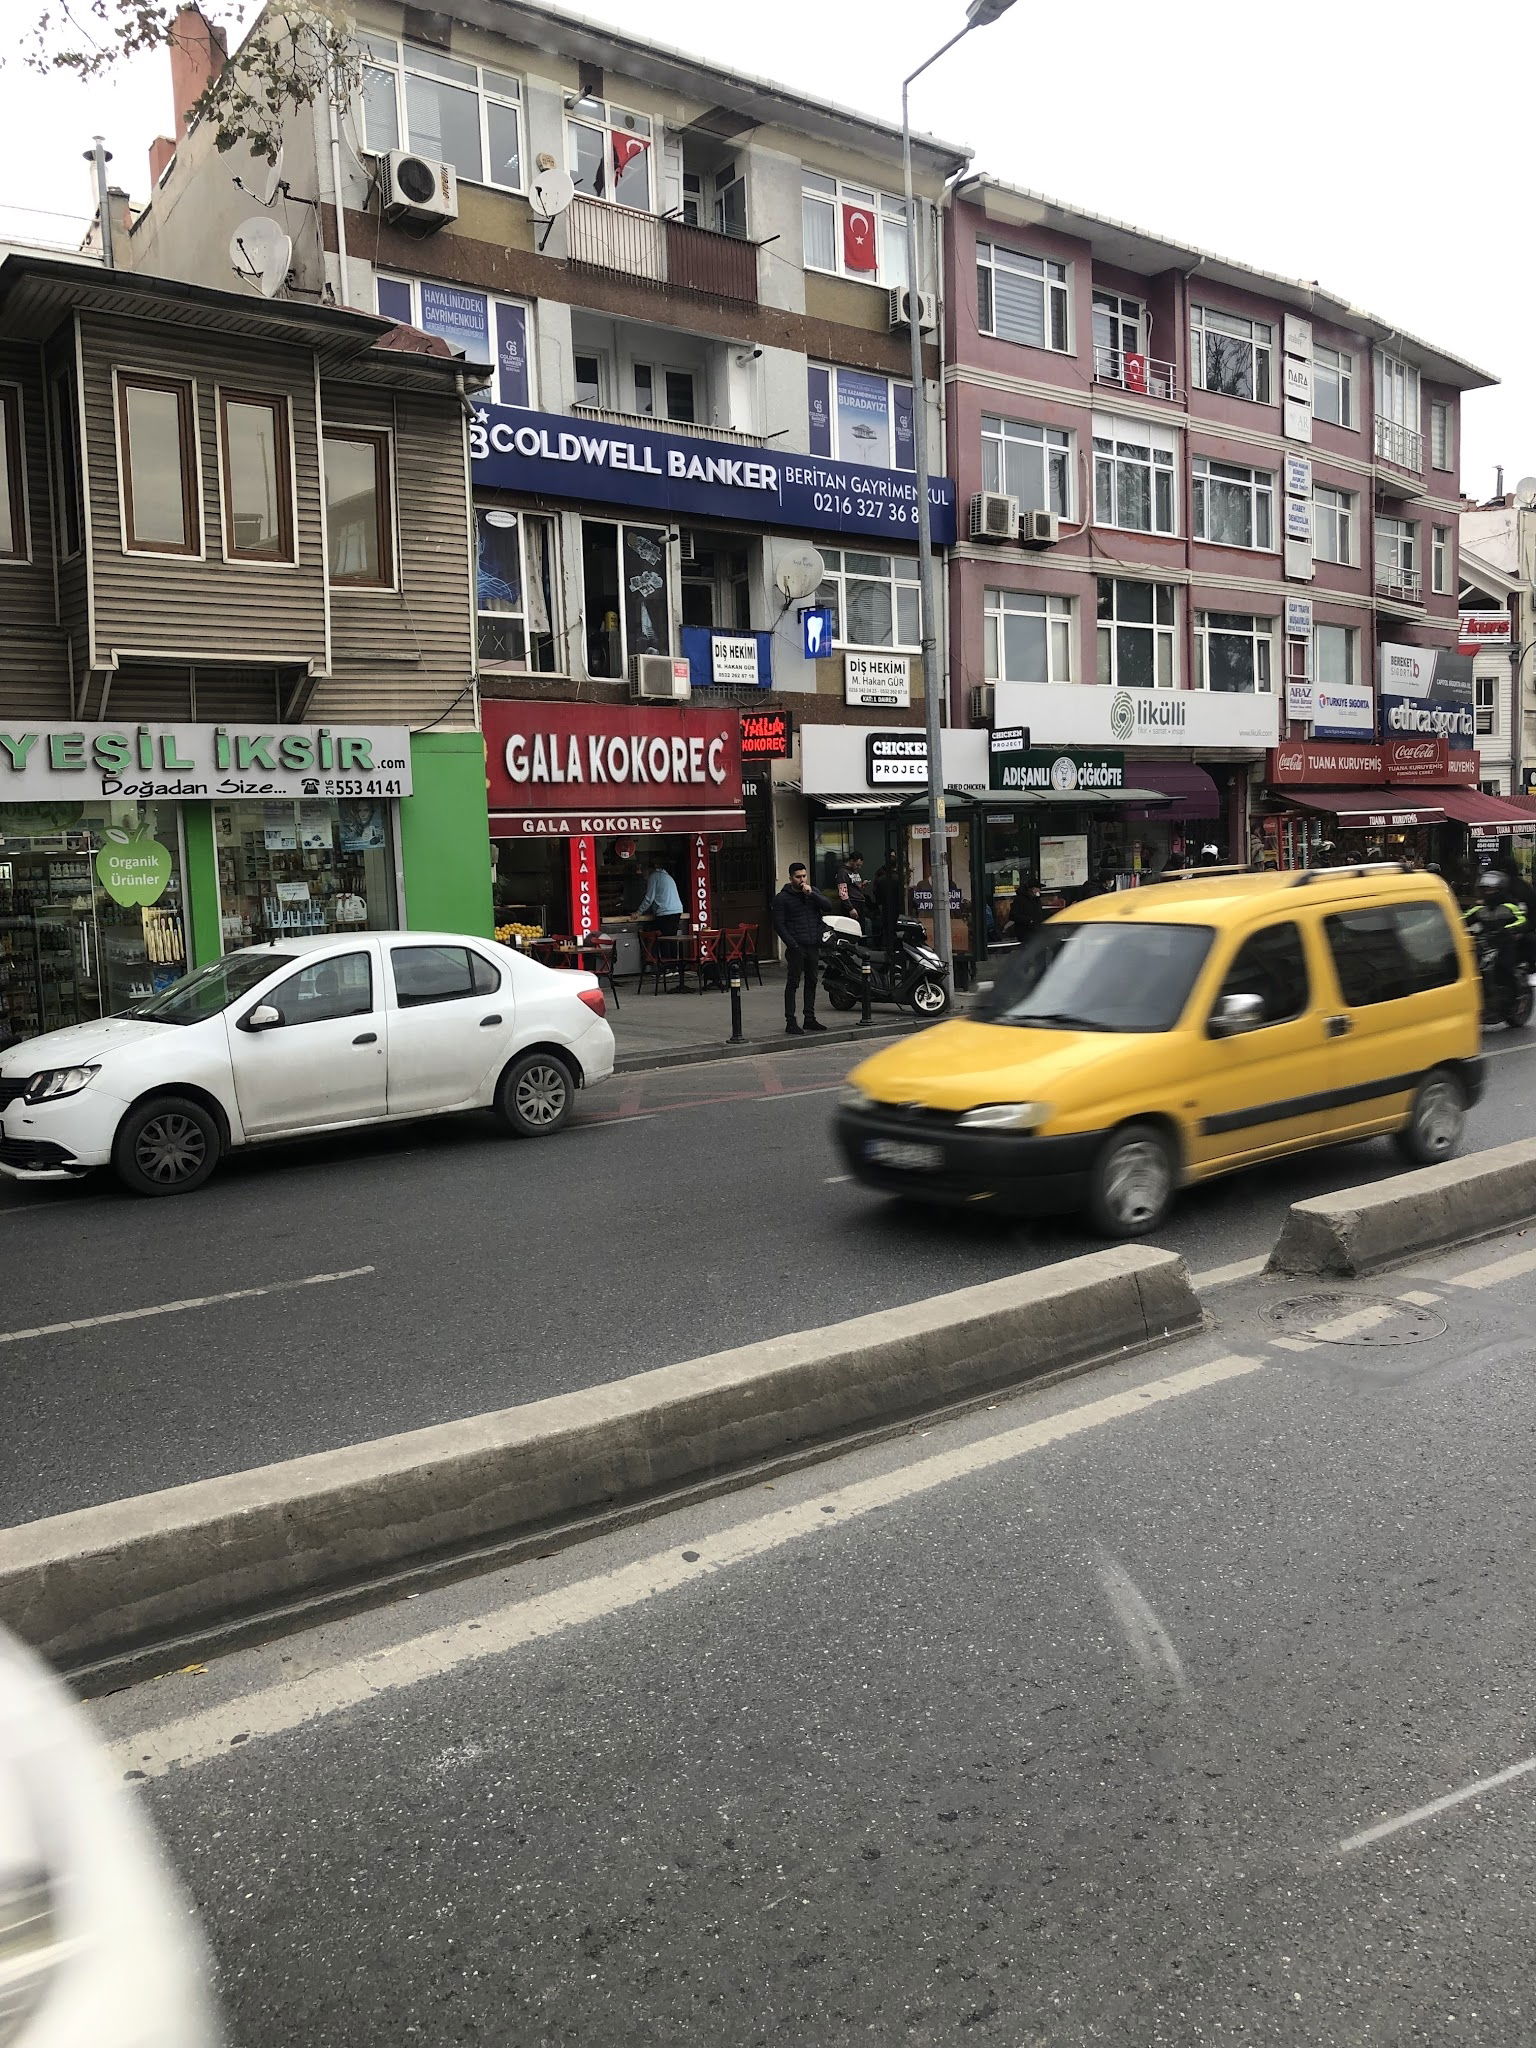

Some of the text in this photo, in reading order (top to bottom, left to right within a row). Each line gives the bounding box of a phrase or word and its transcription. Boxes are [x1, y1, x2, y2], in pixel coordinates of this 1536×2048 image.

[424, 290, 484, 313] HAYALİNİZDEKİ
[425, 307, 484, 330] GAYRİMENKULÜ
[838, 394, 887, 413] BURADAYIZ!
[490, 423, 662, 475] COLDWELL
[668, 449, 778, 491] BANKER
[785, 465, 847, 490] BERİTAN
[814, 492, 920, 524] 0216 327 36 8
[715, 641, 756, 661] DİŞ HEKİMİ
[850, 658, 906, 675] DİŞ HEKİMİ
[1391, 656, 1412, 668] BEREKET
[852, 676, 904, 687] M. Hakan GÜR
[1290, 687, 1312, 698] ARAZ
[1137, 700, 1185, 725] likülli
[992, 730, 1022, 739] CHICKEN
[0, 726, 196, 778] YEŞİL
[215, 727, 376, 770] İKSİR
[742, 737, 786, 752] KOKOREÇ
[506, 734, 727, 785] GALA KOKOREÇ
[1308, 755, 1382, 772] TUANA KURUYEMİŞ
[336, 781, 362, 795] 553
[366, 780, 382, 795] 41
[386, 780, 401, 795] 41
[1002, 766, 1050, 790] ADIŞANLI
[102, 779, 286, 798] Doğadan Size...
[522, 817, 662, 833] GALA KOKOREÇ
[579, 839, 588, 873] ALA
[696, 835, 705, 870] ALA
[109, 856, 158, 869] Organik
[111, 873, 159, 886] Ürünler
